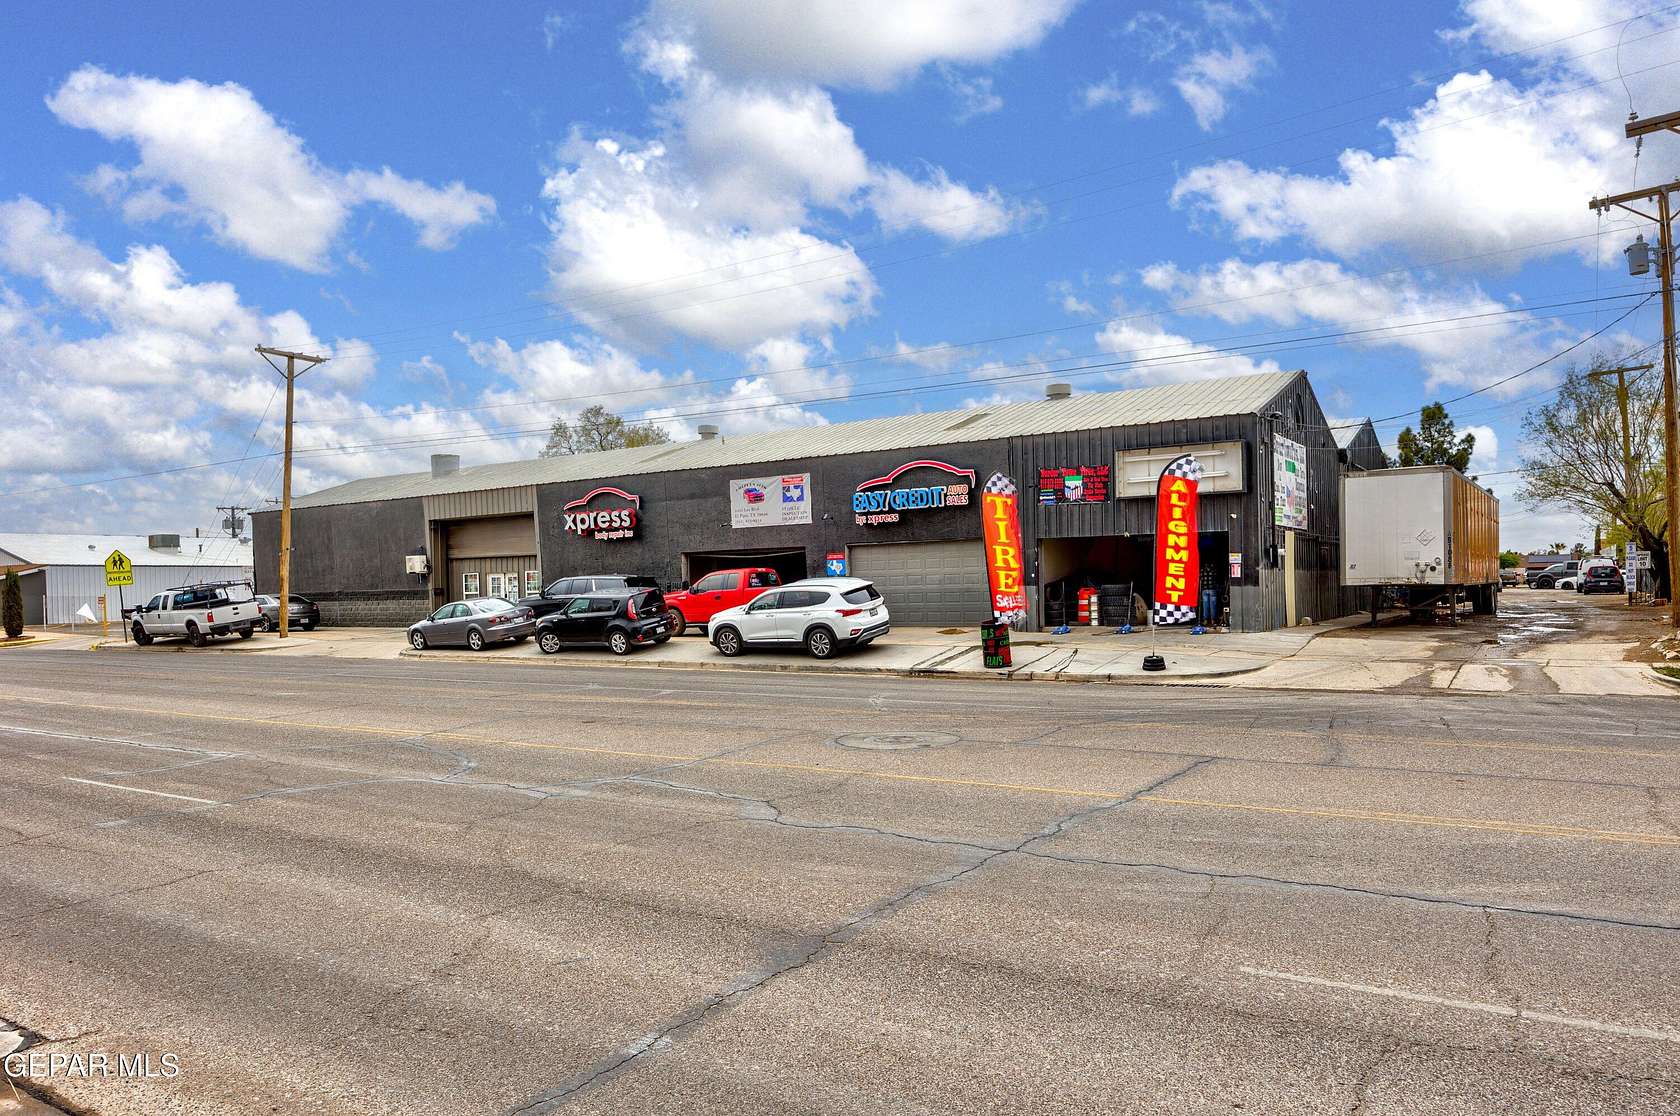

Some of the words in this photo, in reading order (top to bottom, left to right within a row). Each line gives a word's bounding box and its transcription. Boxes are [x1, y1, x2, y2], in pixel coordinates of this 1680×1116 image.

[947, 485, 968, 495] AUTO
[852, 490, 890, 512] EASY
[890, 486, 947, 510] CREDIT
[946, 495, 968, 505] SALES
[564, 509, 633, 535] xpress
[867, 514, 899, 526] xpress
[594, 531, 609, 540] body
[609, 530, 625, 540] repair
[1165, 479, 1188, 602] ALIGNMENT
[987, 496, 1020, 592] TIRE
[986, 655, 1003, 666] FLATS
